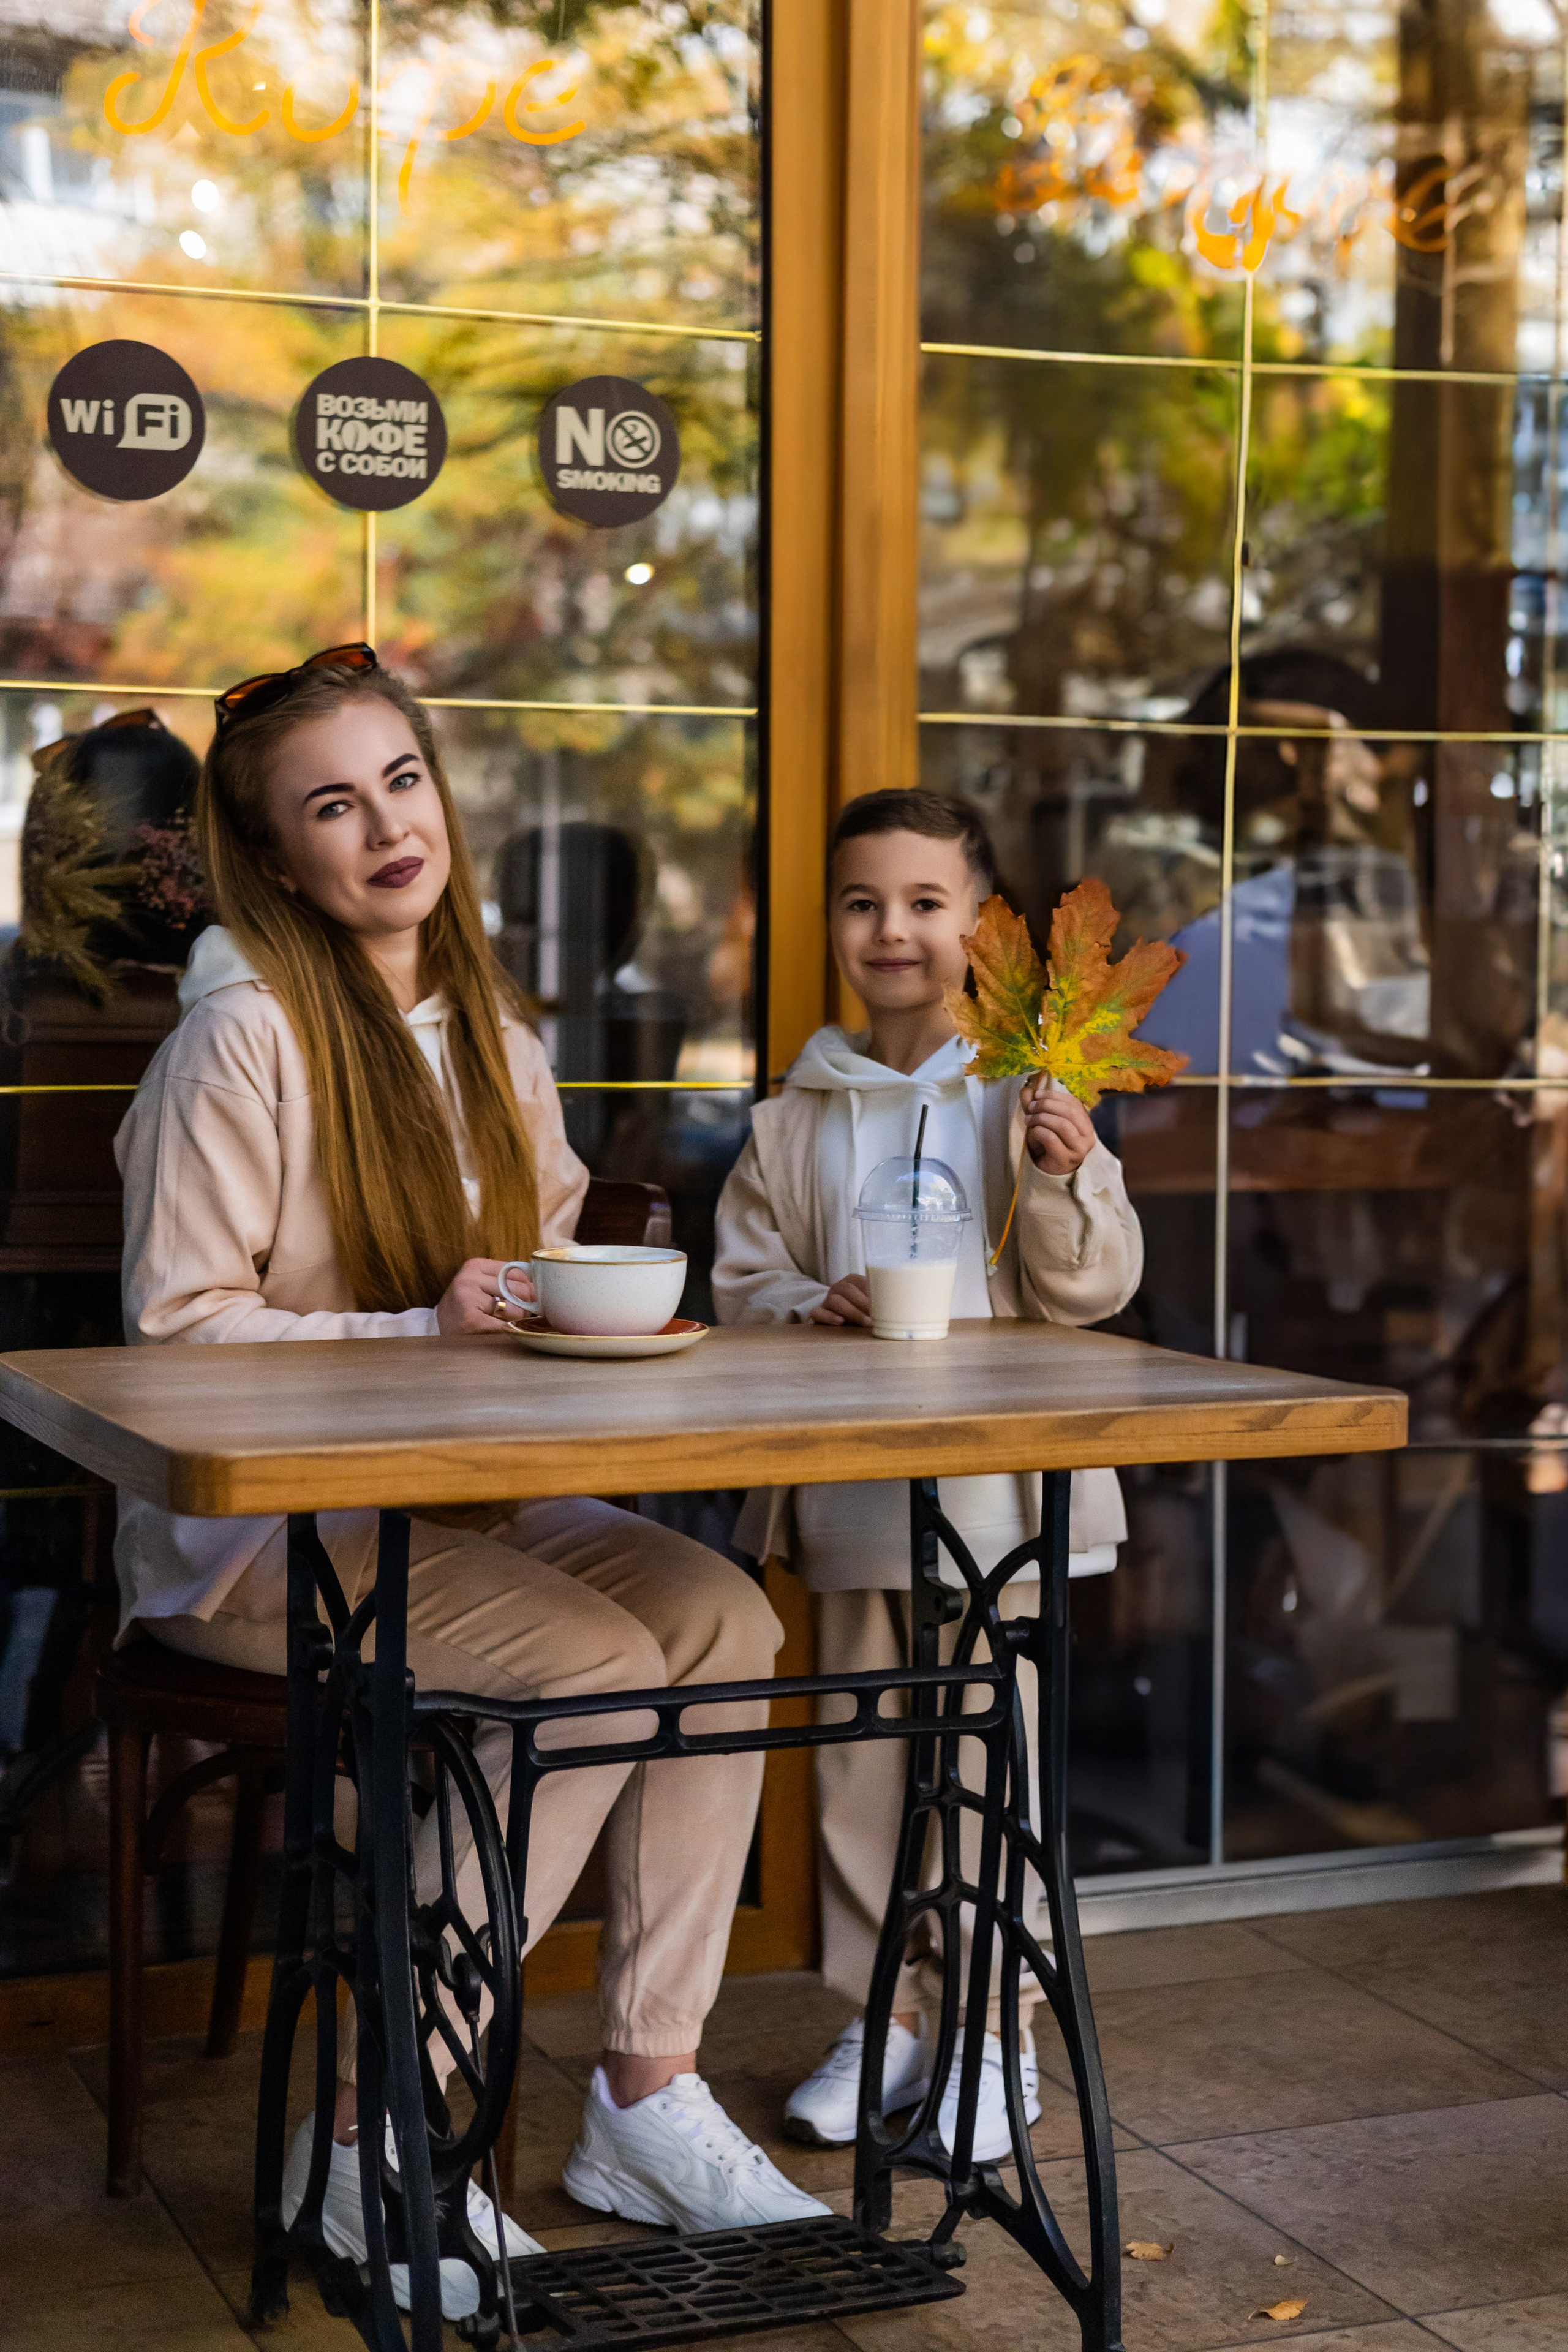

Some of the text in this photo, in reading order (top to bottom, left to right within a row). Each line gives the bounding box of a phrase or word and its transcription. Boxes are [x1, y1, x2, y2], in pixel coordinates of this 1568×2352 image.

[316, 393, 428, 424] ВОЗЬМИ
[316, 417, 428, 457] КОФЕ
[316, 451, 337, 473] С
[556, 469, 662, 494] SMOKING
